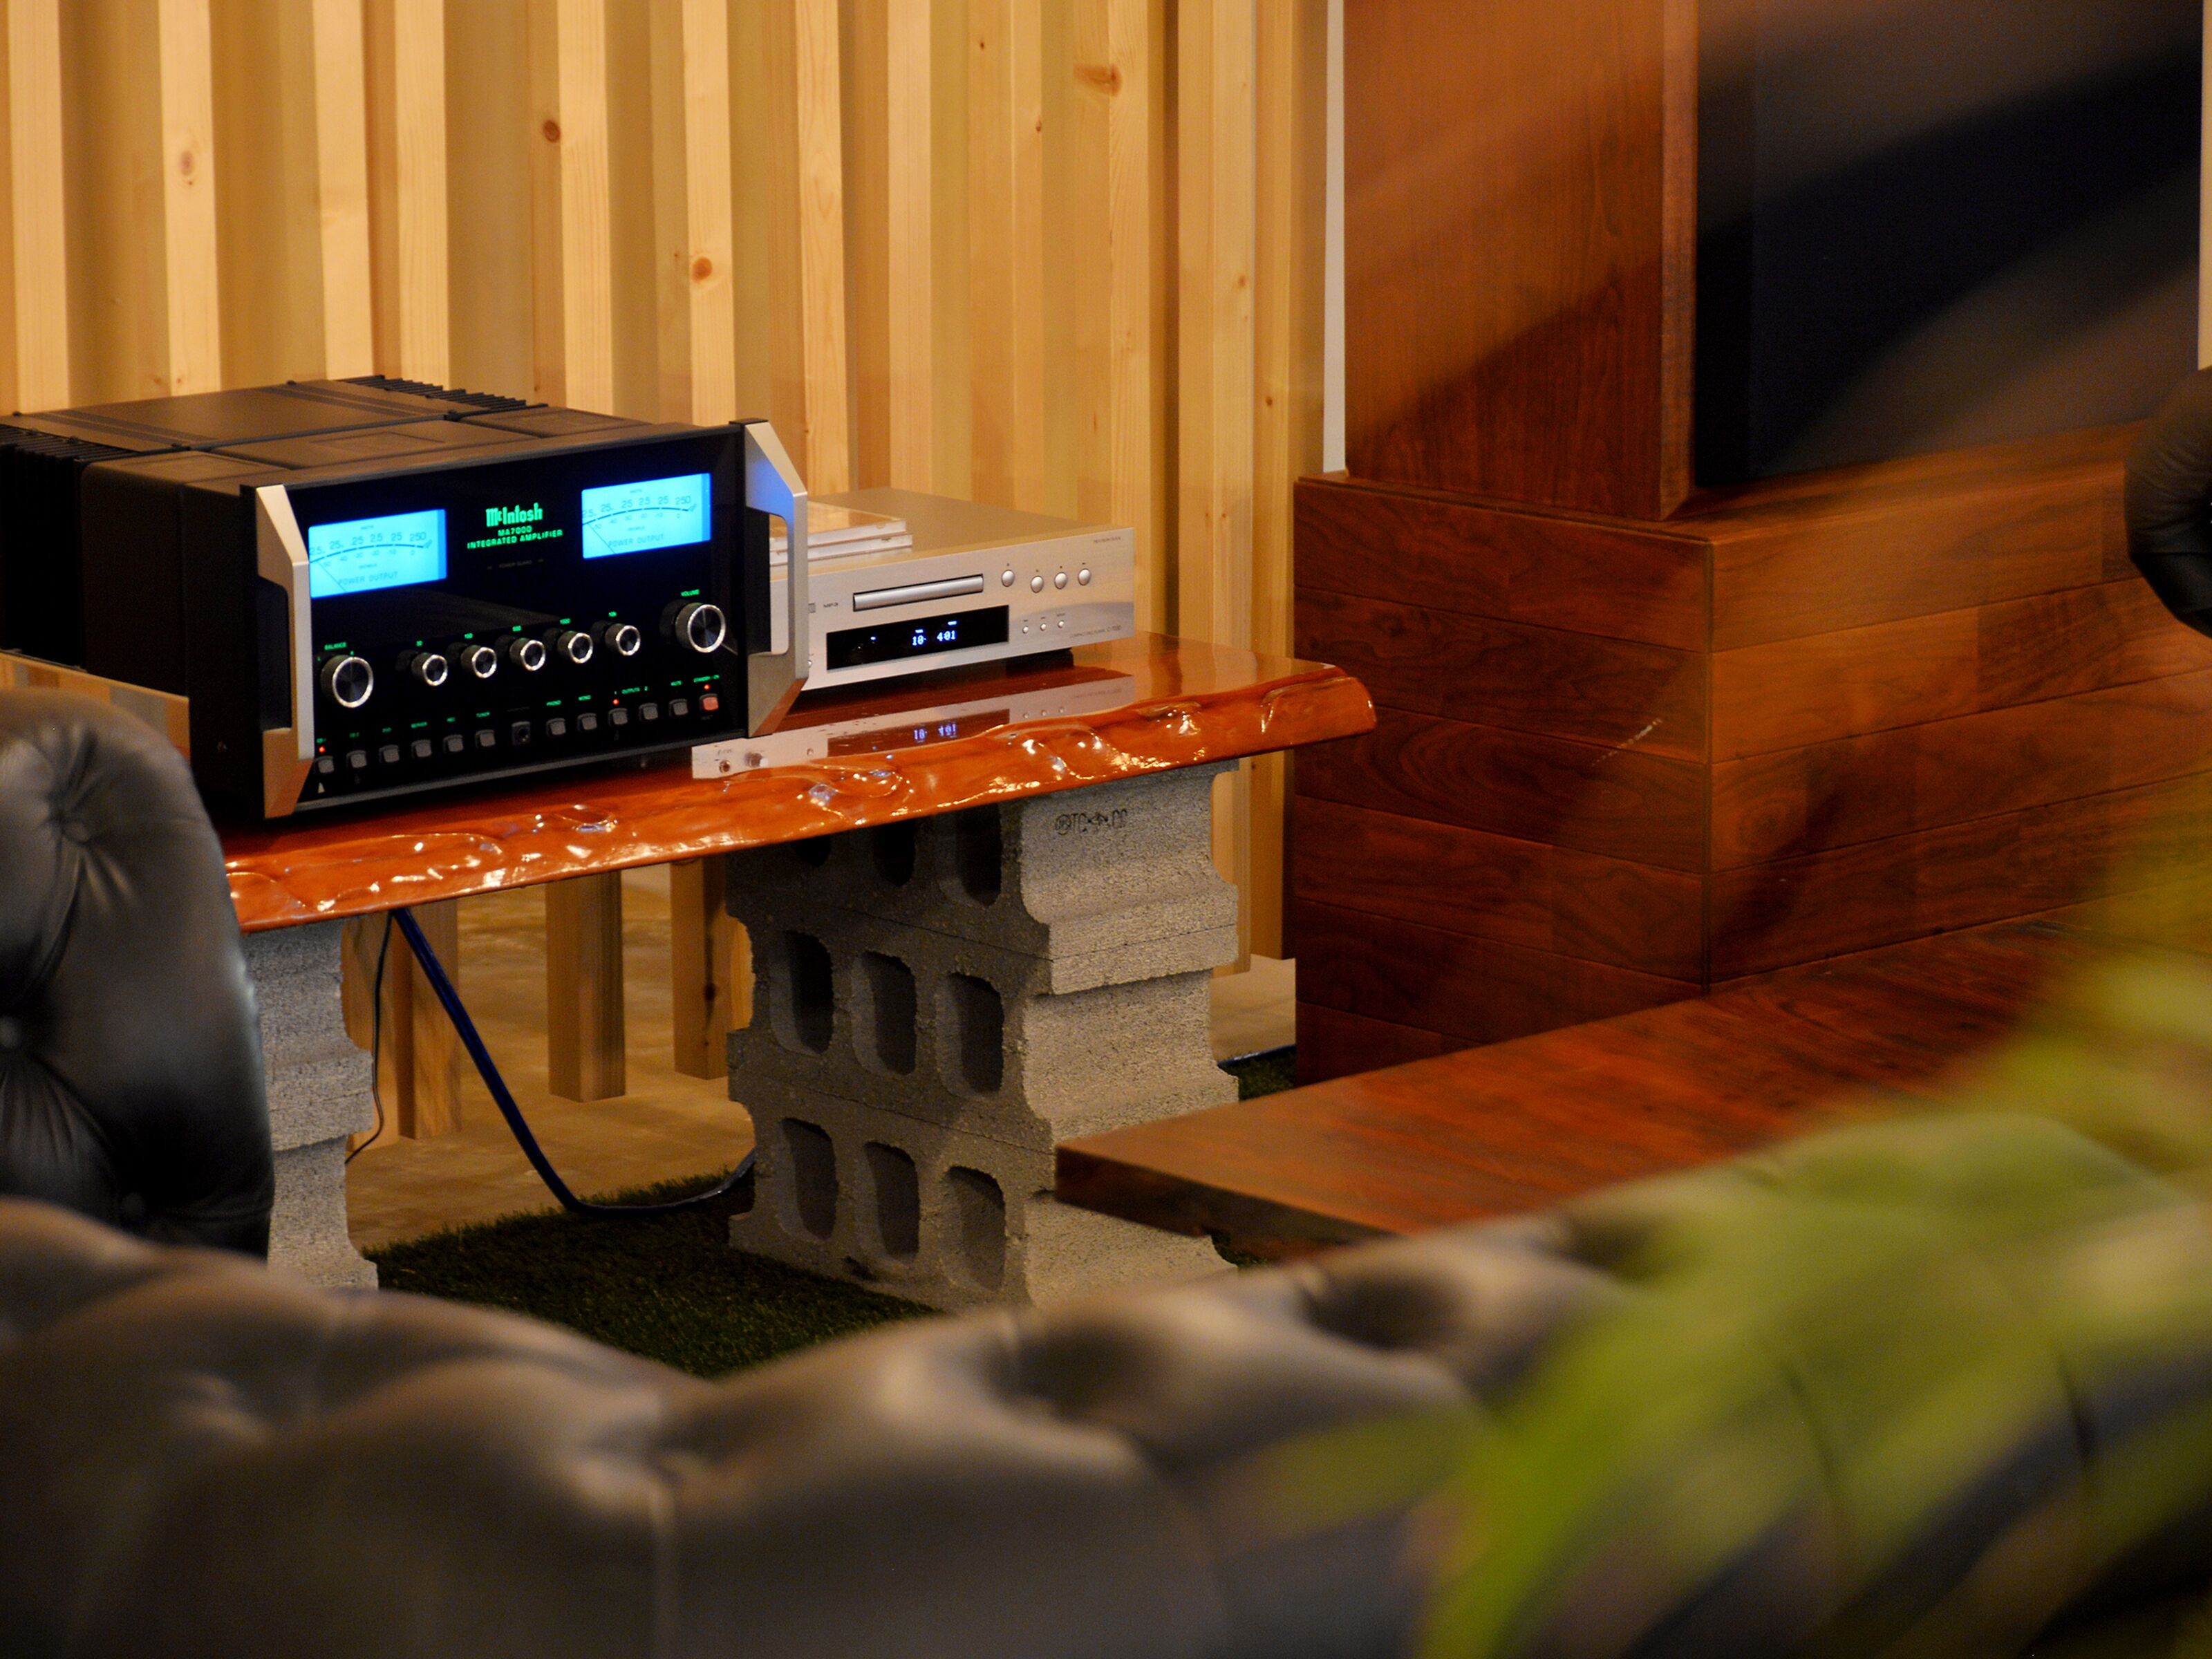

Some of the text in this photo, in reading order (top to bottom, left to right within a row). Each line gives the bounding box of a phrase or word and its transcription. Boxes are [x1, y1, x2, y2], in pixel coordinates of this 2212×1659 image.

[675, 495, 691, 505] 250
[485, 502, 543, 527] McIntosh
[498, 525, 532, 536] MA7000
[409, 531, 427, 542] 250
[467, 529, 563, 549] INTEGRATED AMPLIFIER
[324, 641, 346, 650] BALANCE
